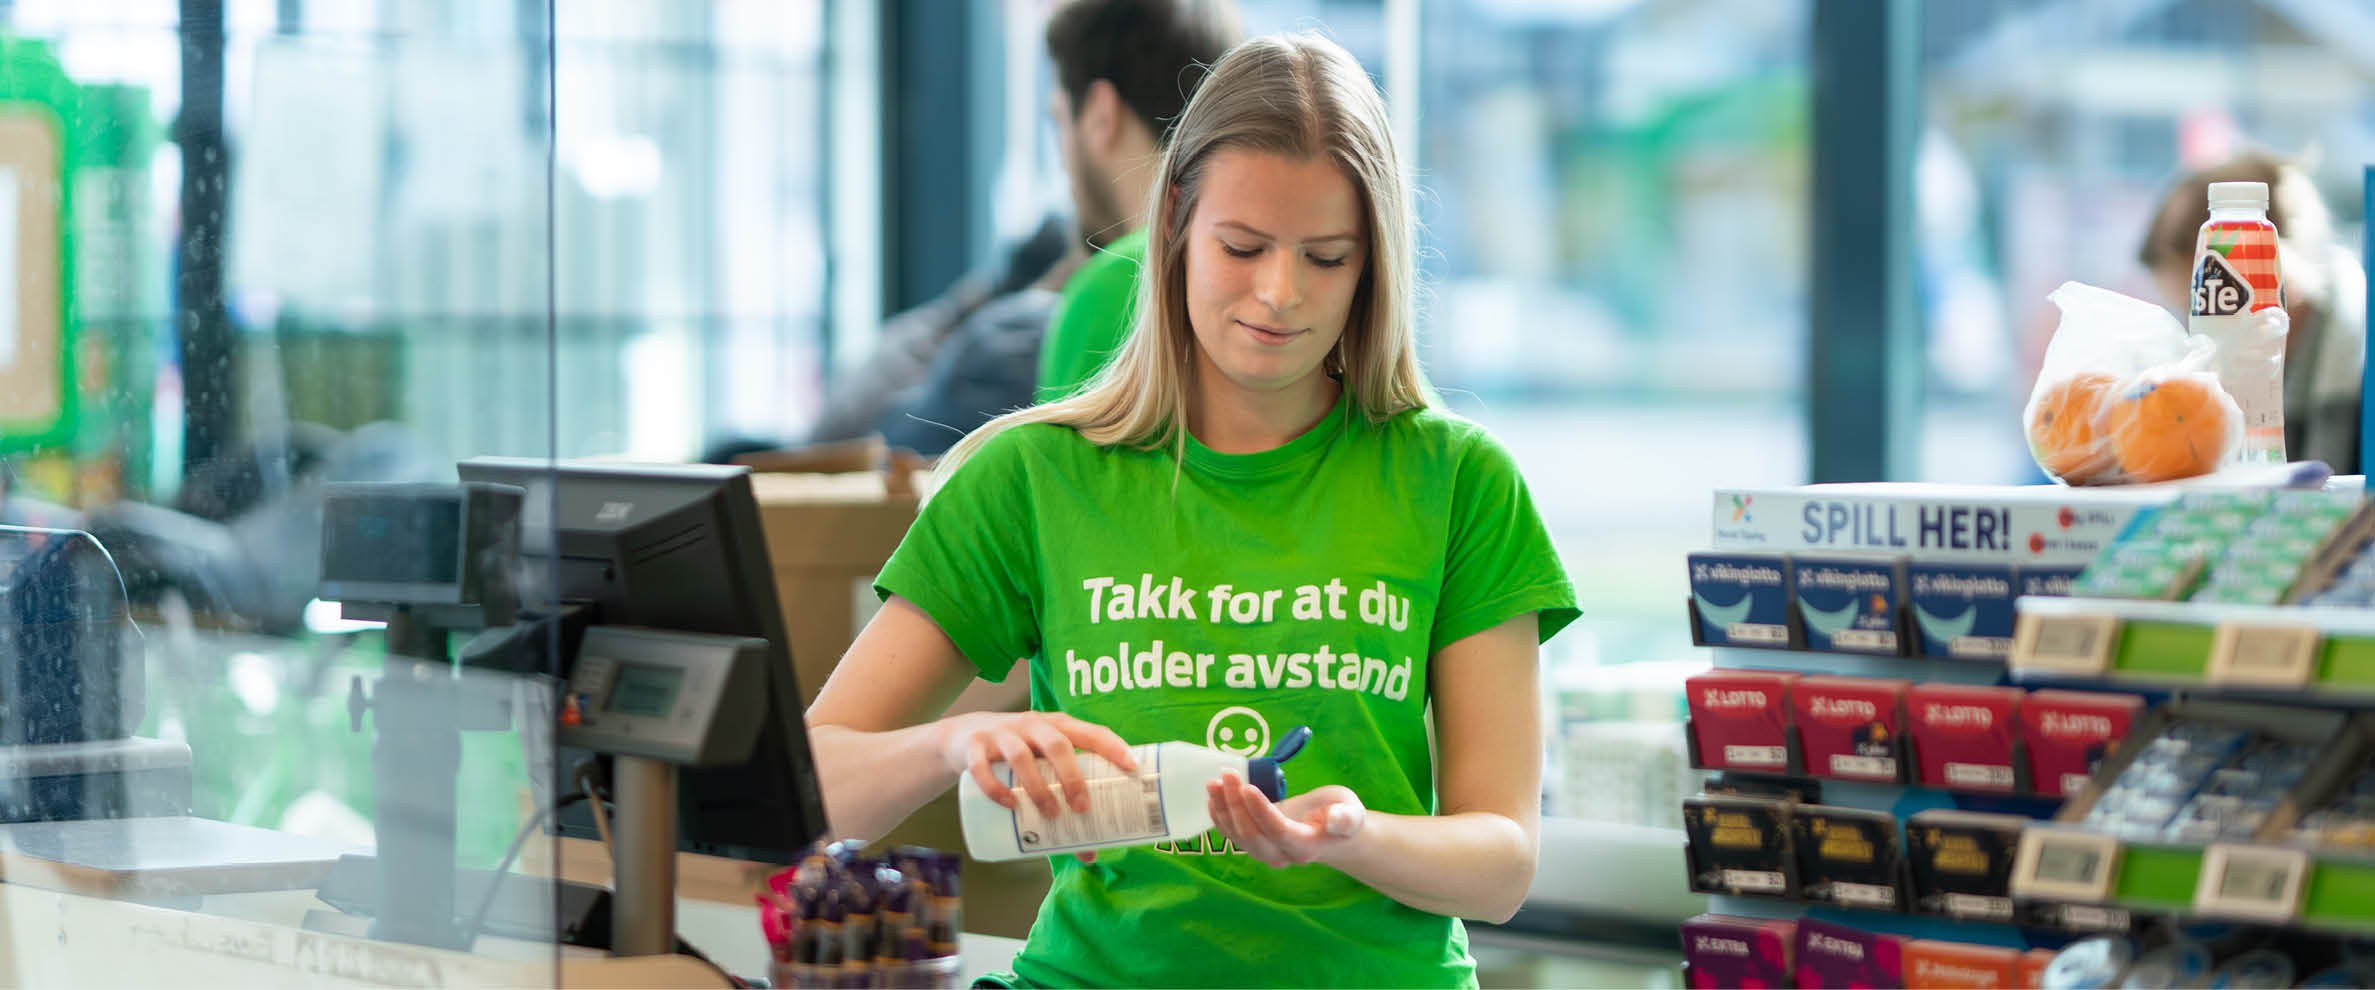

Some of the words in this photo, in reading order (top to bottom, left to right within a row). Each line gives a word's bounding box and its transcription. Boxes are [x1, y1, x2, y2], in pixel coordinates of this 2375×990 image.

[1803, 501, 1906, 547] SPILL
[1920, 505, 2009, 551] HER!
[1083, 573, 1198, 625] Takk
[1207, 583, 1283, 624] for
[1292, 578, 1347, 620] at
[1359, 580, 1410, 631] du
[1066, 639, 1215, 696] holder
[1225, 645, 1412, 701] avstand
[1721, 690, 1767, 708] LOTTO
